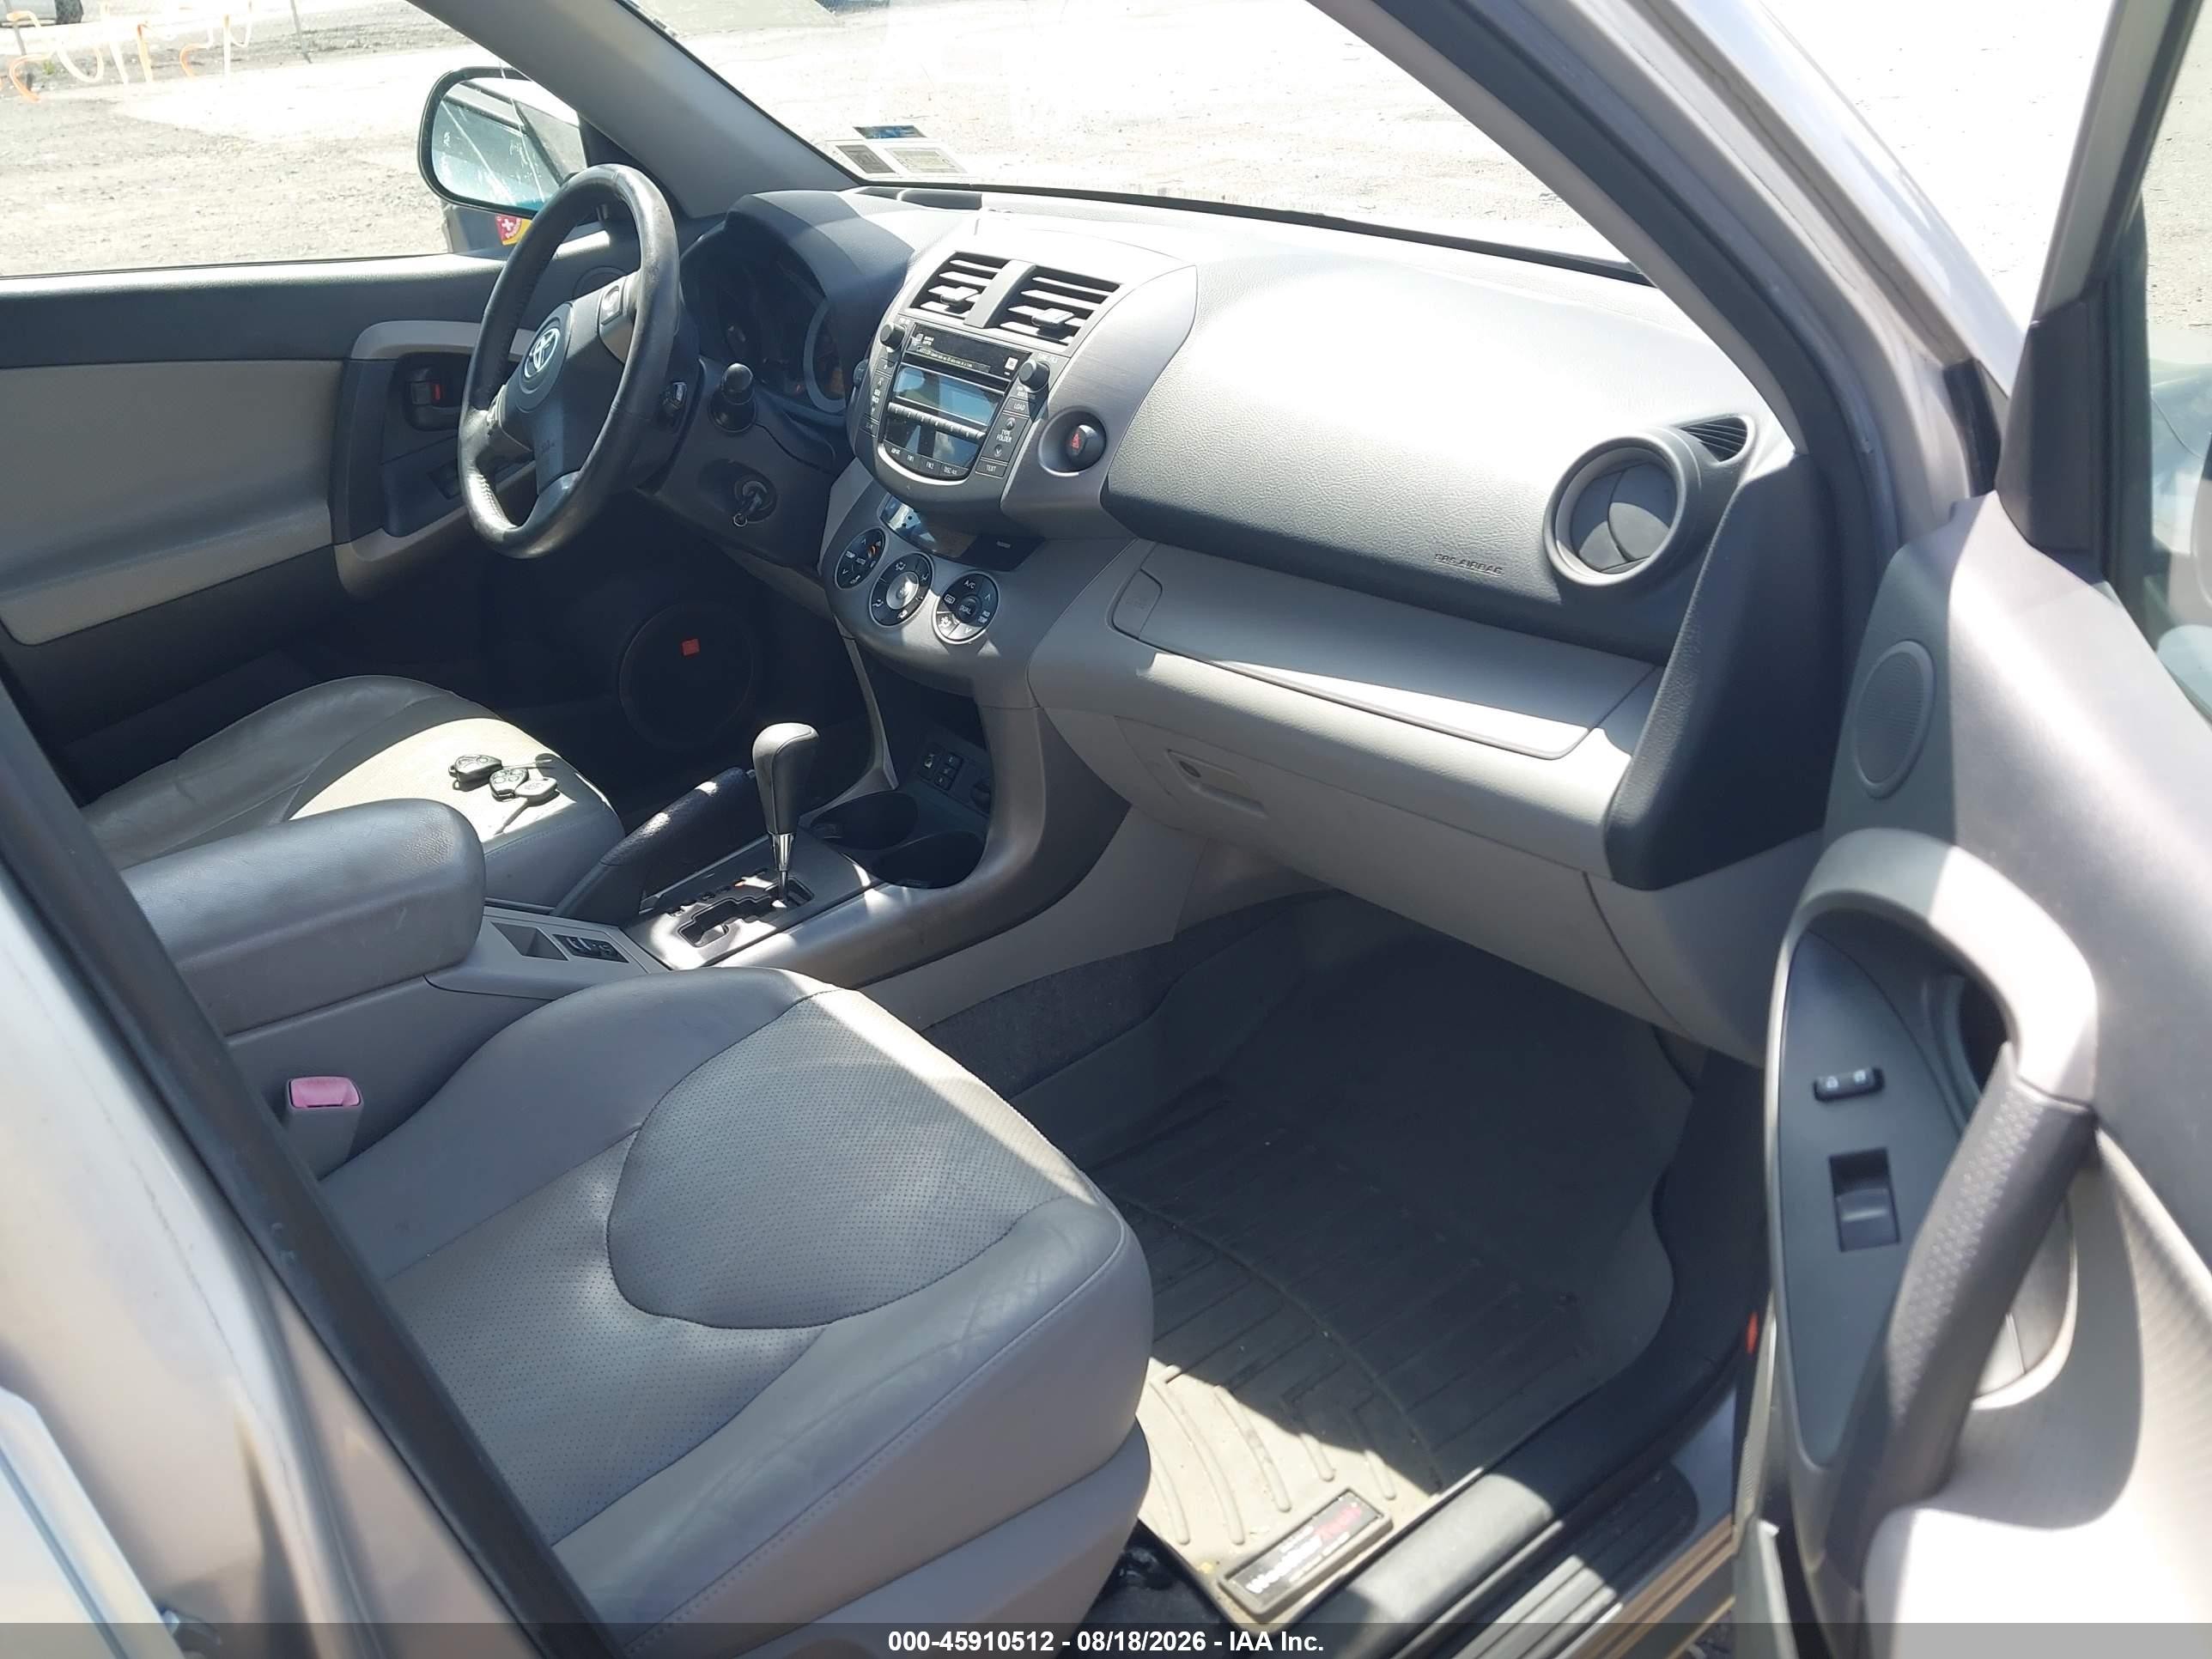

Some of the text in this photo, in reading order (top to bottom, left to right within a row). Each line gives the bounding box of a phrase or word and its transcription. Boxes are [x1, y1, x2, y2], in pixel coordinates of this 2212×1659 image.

[996, 434, 1012, 443] FOLDER
[963, 580, 976, 590] A/C
[958, 604, 972, 616] DUAL
